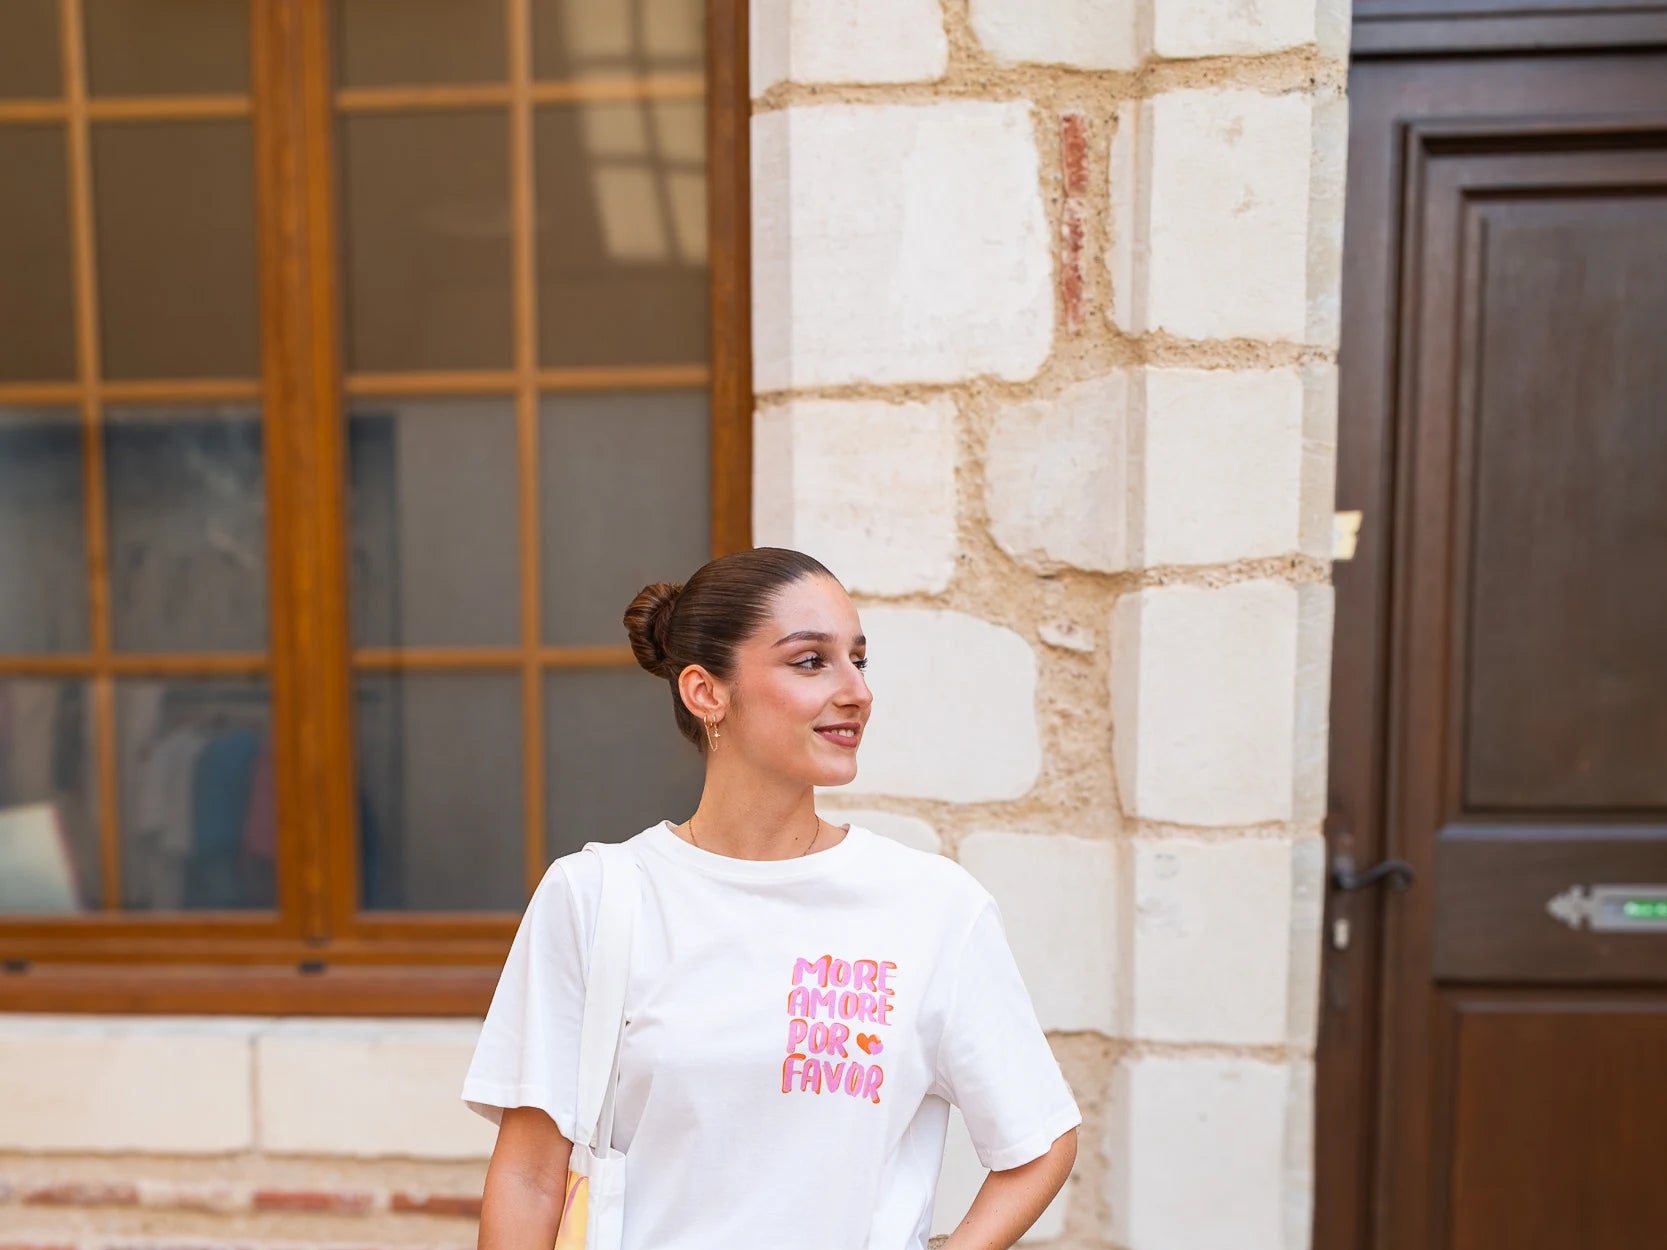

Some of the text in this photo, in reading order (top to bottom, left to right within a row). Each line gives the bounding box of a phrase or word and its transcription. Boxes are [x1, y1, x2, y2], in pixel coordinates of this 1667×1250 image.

[792, 955, 897, 995] MORE
[787, 986, 894, 1026] AMORE
[786, 1018, 850, 1058] POR
[781, 1053, 884, 1104] FAVOR
